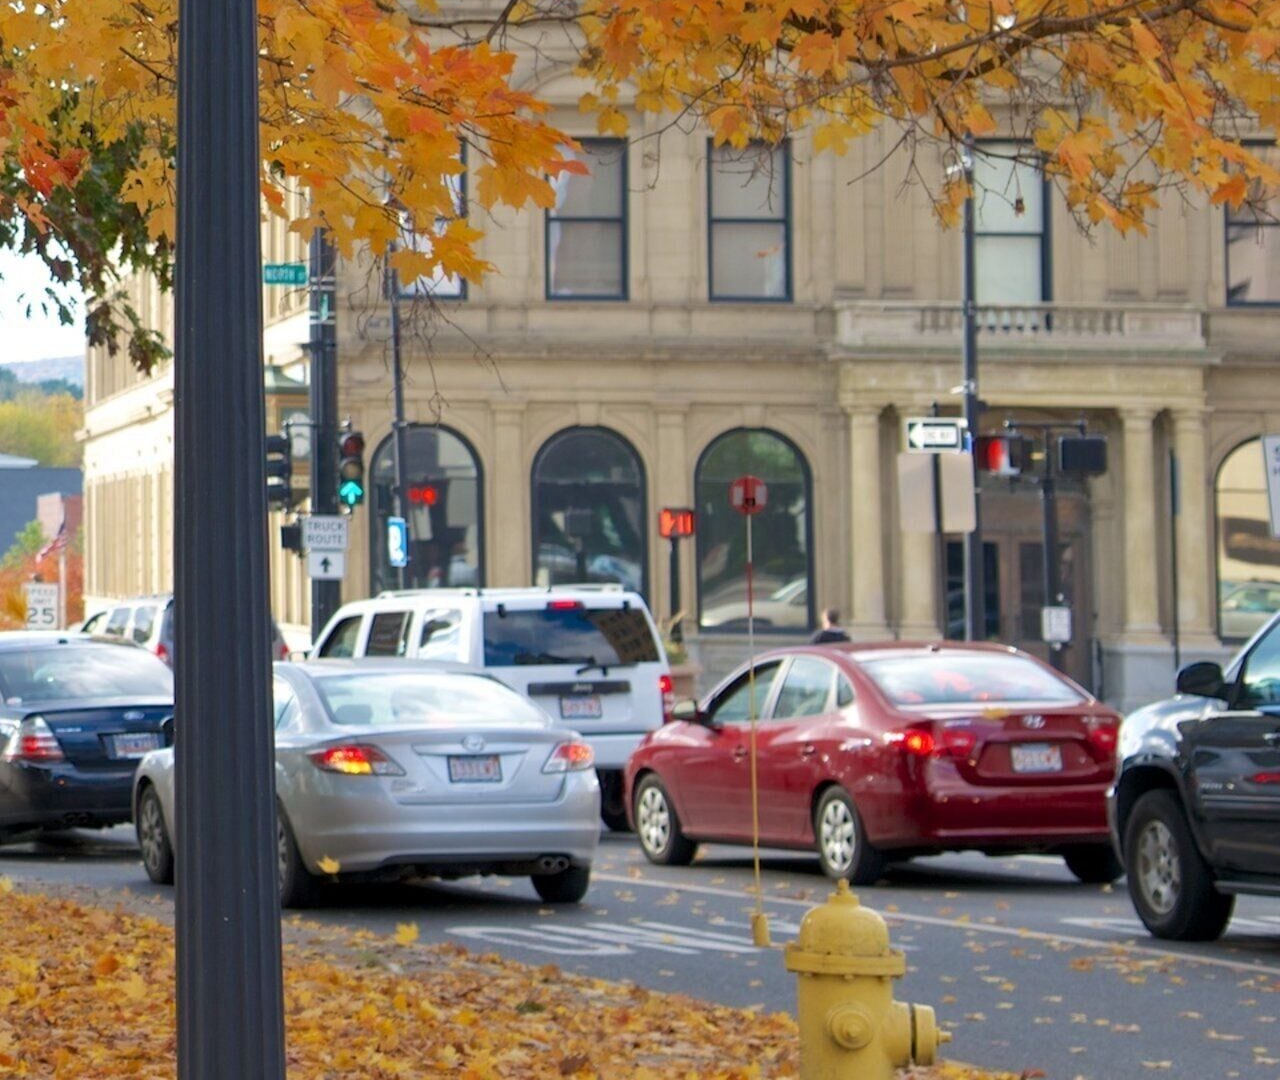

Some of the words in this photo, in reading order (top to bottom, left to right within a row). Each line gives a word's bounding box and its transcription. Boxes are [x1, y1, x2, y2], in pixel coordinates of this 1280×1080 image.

[307, 521, 343, 531] TRUCK
[307, 534, 342, 544] ROUTE
[27, 607, 55, 625] 25
